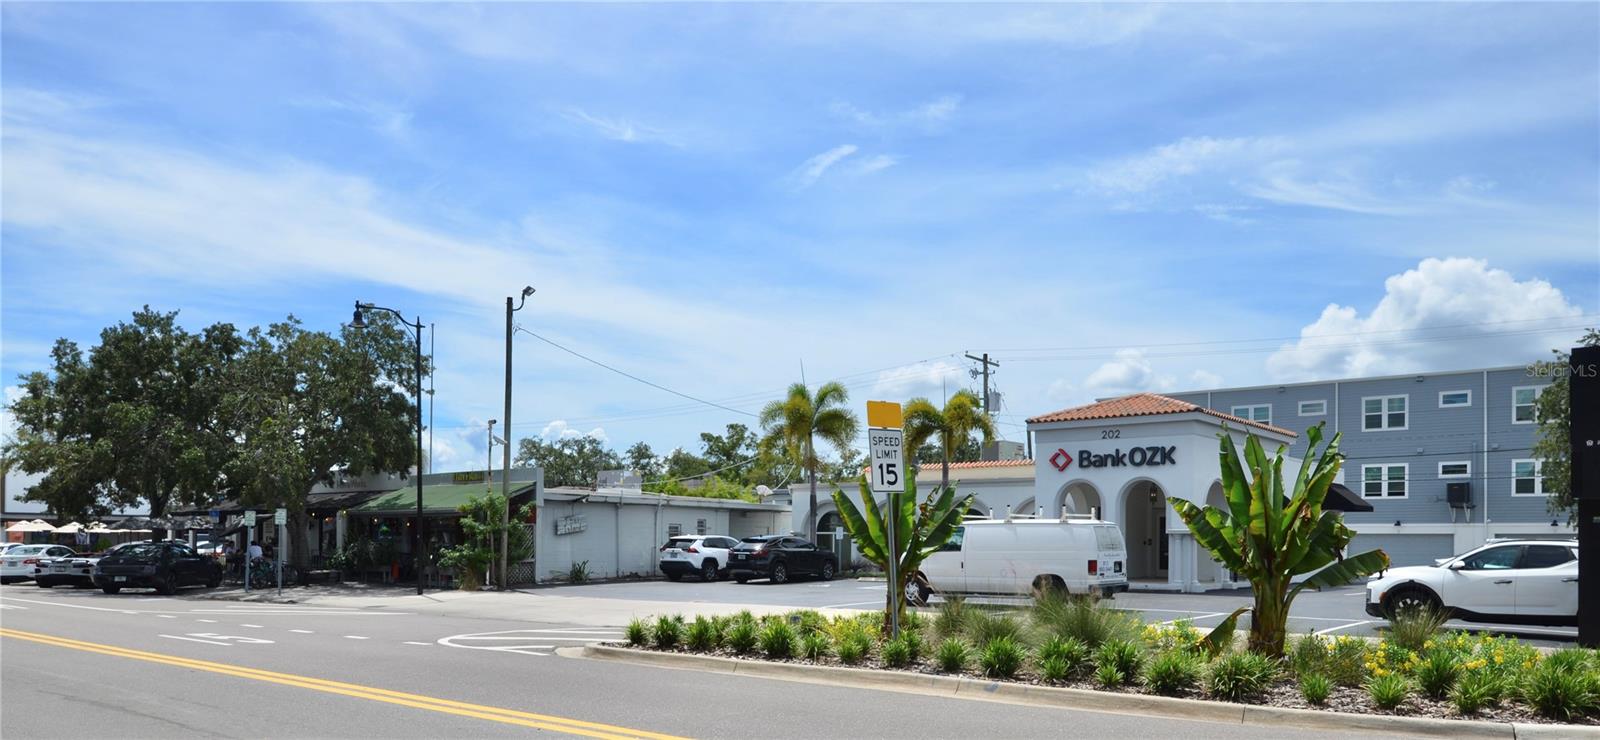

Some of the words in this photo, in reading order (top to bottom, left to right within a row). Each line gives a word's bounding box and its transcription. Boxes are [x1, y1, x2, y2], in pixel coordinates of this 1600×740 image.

[1101, 429, 1121, 439] 202
[872, 436, 900, 447] SPEED
[876, 449, 898, 459] LIMIT
[1078, 448, 1127, 468] Bank
[1128, 446, 1177, 467] OZK
[878, 463, 898, 486] 15
